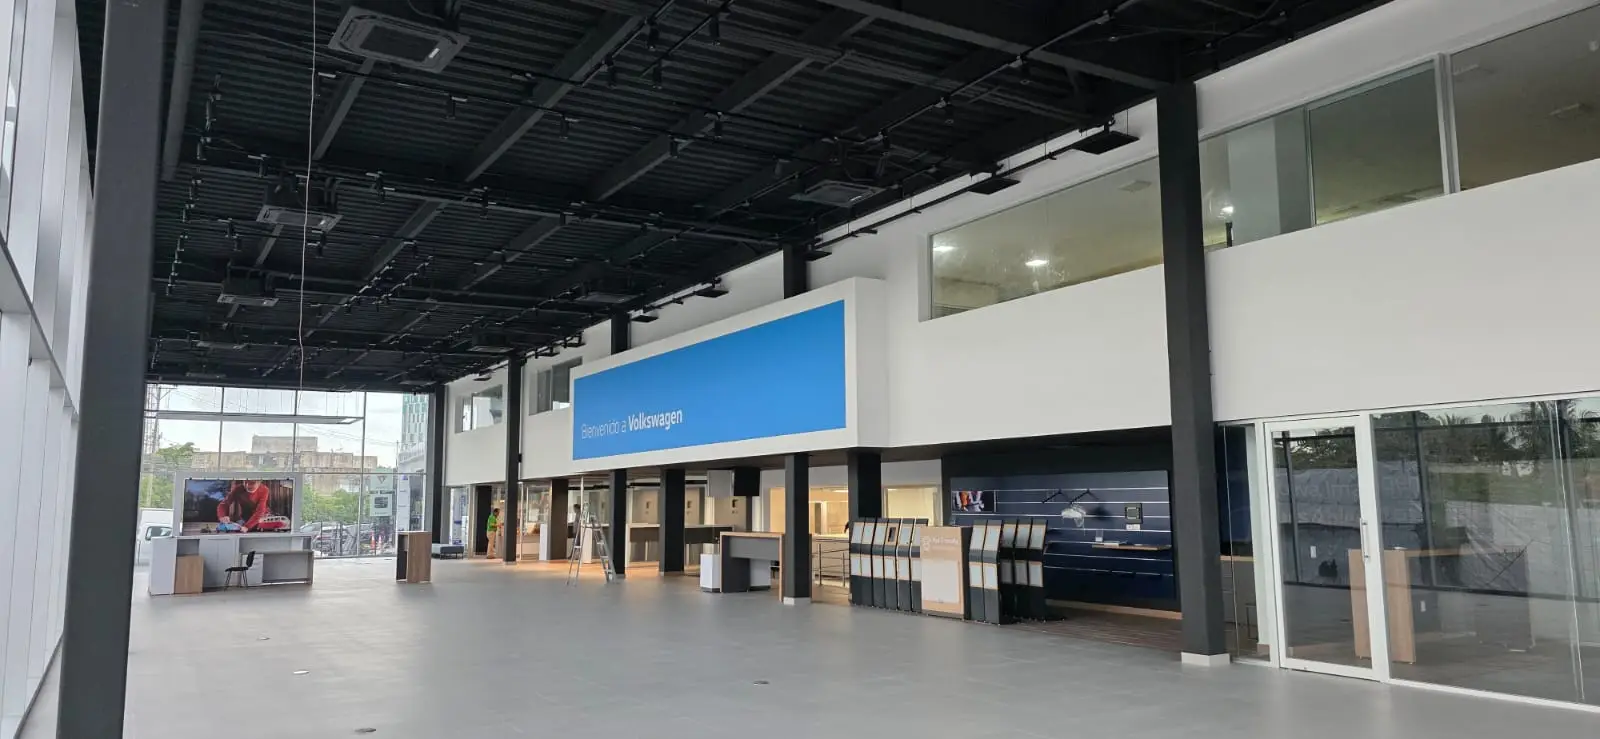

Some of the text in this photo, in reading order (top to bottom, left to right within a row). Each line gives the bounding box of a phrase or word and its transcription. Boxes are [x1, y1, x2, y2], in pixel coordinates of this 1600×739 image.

[581, 409, 683, 439] Bienvenido a Volkswagen
